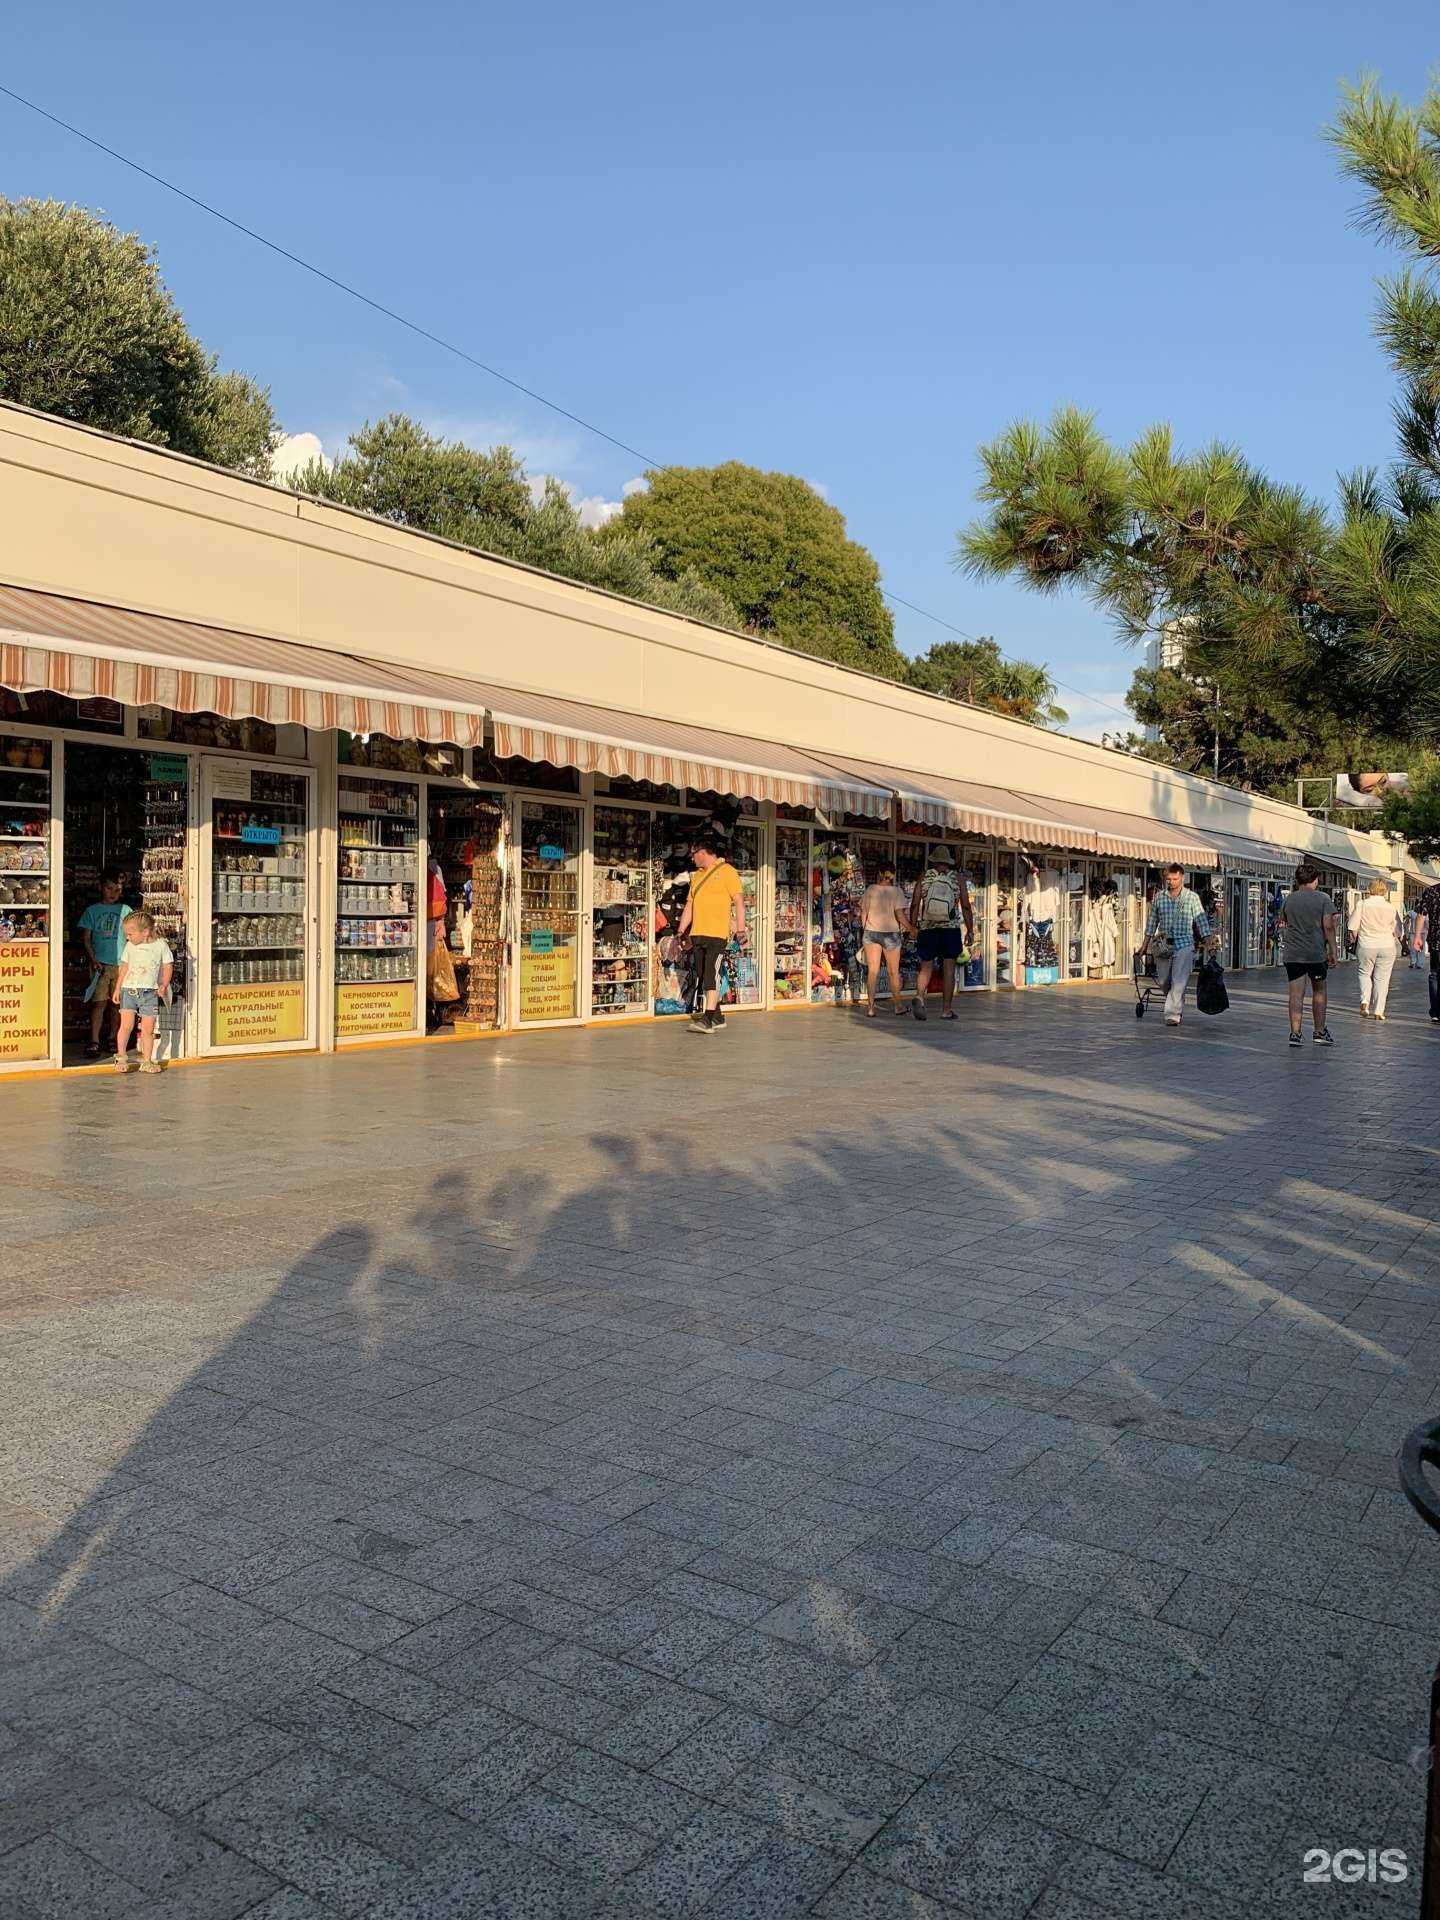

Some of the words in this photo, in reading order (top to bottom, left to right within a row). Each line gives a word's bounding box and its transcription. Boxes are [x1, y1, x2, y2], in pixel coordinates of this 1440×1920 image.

[244, 829, 278, 842] ОТКРЫТО
[533, 964, 555, 972] ТРАВЫ
[530, 975, 557, 983] СПЕЦИИ
[277, 988, 301, 998] МАЗИ
[342, 991, 400, 1000] ЧЕРНОМОРСКАЯ
[219, 1002, 285, 1014] НАТУРАЛЬНЫЕ
[350, 1002, 392, 1010] КОСМЕТИКА
[0, 1014, 18, 1024] КИ
[227, 1015, 277, 1026] БАЛЬЗАМЫ
[335, 1023, 379, 1033] УЛИТОЧНЫЕ
[380, 1021, 403, 1030] КРЕМА
[3, 1028, 47, 1039] ЛОЖКИ
[227, 1027, 277, 1039] ЭЛЕКСИРЫ
